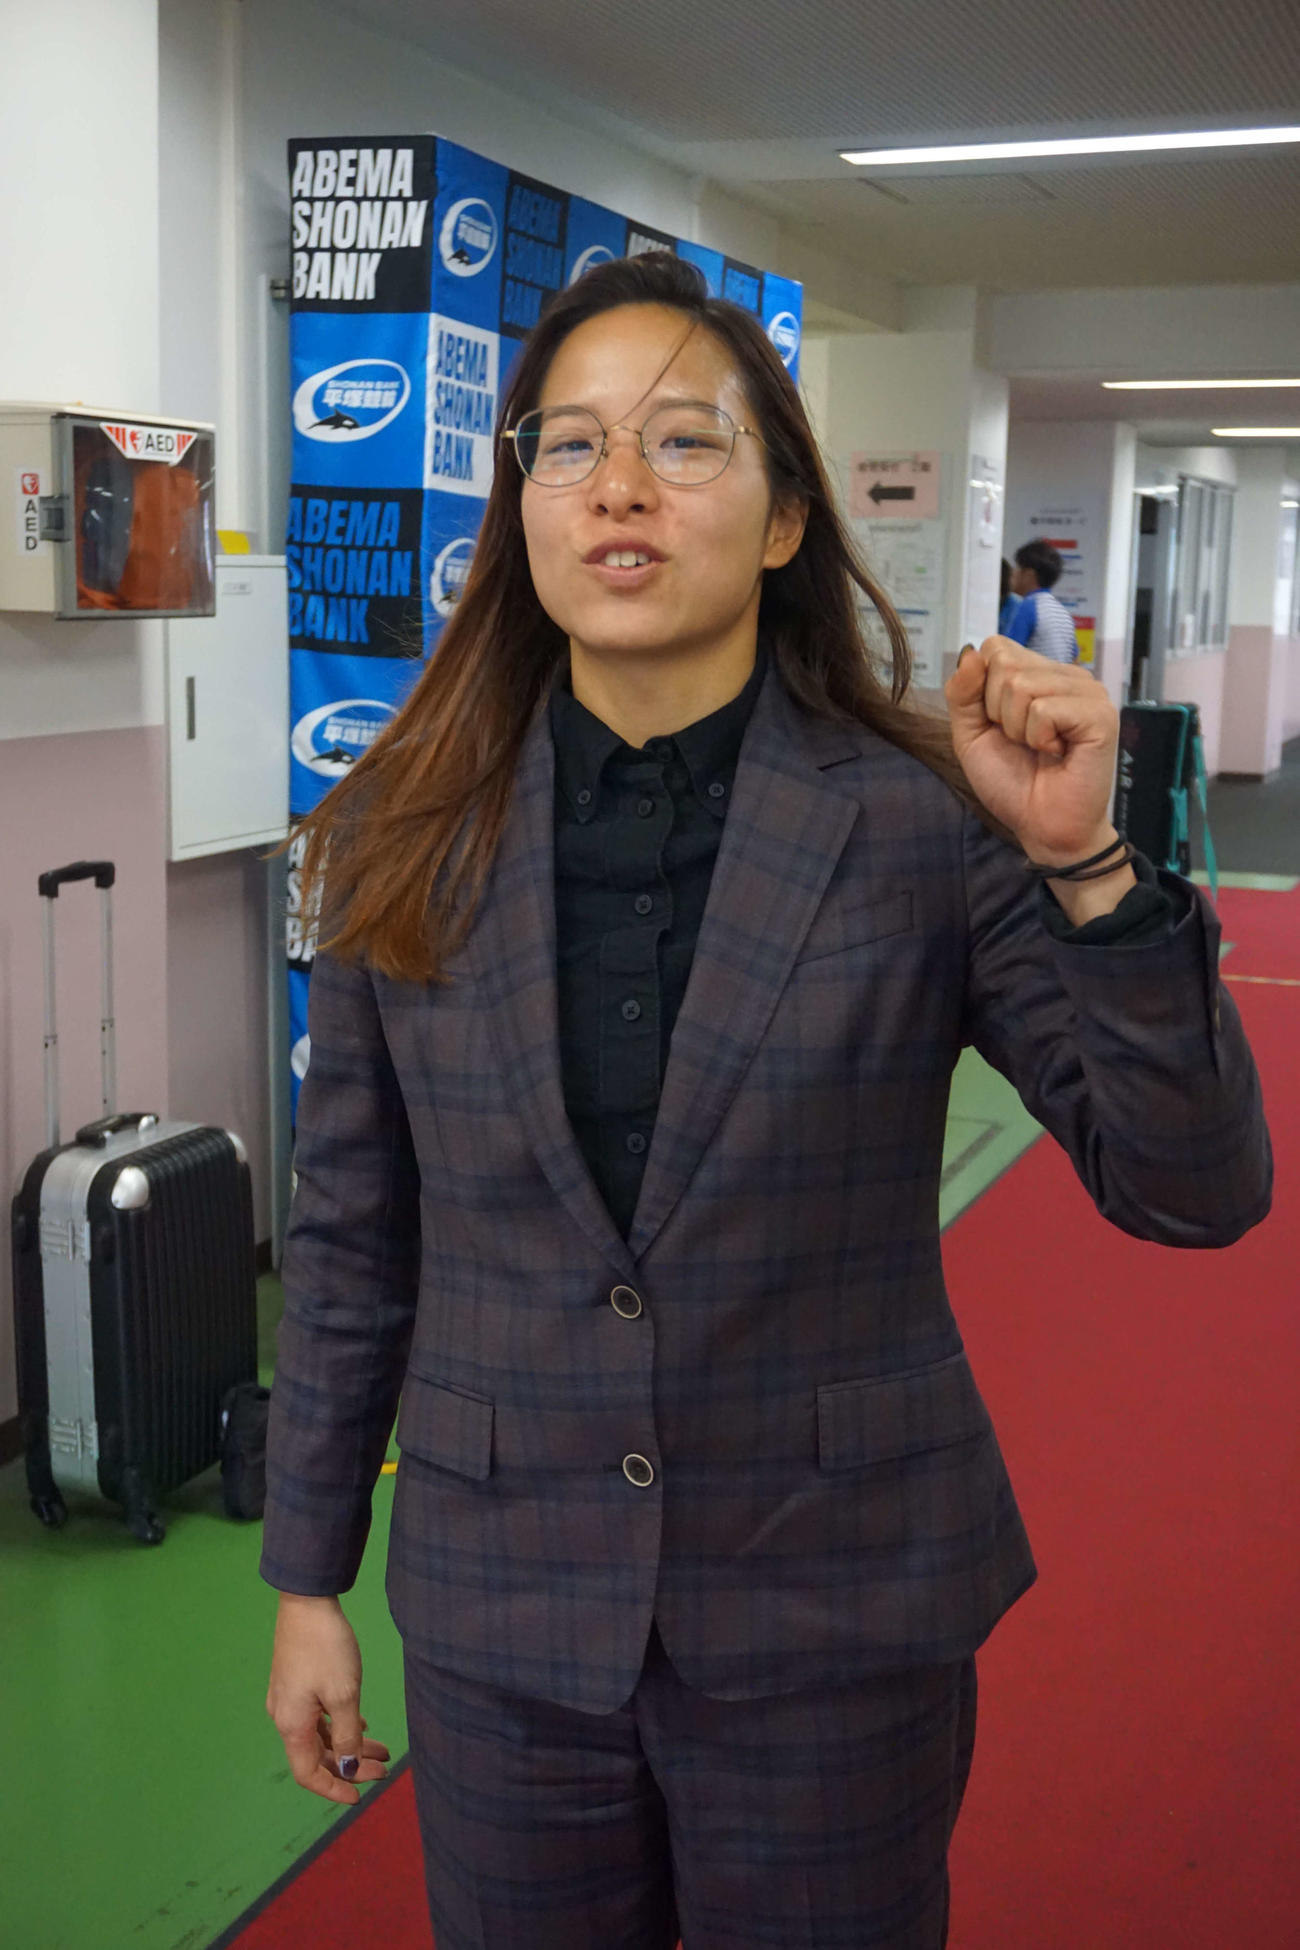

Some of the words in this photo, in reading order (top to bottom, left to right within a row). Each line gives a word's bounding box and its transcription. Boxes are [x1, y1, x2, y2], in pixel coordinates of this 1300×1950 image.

[292, 148, 414, 198] ABEMA
[292, 200, 428, 249] SHONAN
[292, 252, 382, 300] BANK
[436, 330, 489, 388] ABEMA
[434, 380, 494, 437] SHONAN
[145, 433, 174, 452] AED
[432, 427, 475, 481] BANK
[24, 499, 38, 551] AED
[286, 497, 400, 547] ABEMA
[286, 545, 413, 597] SHONAN
[289, 592, 370, 644] BANK
